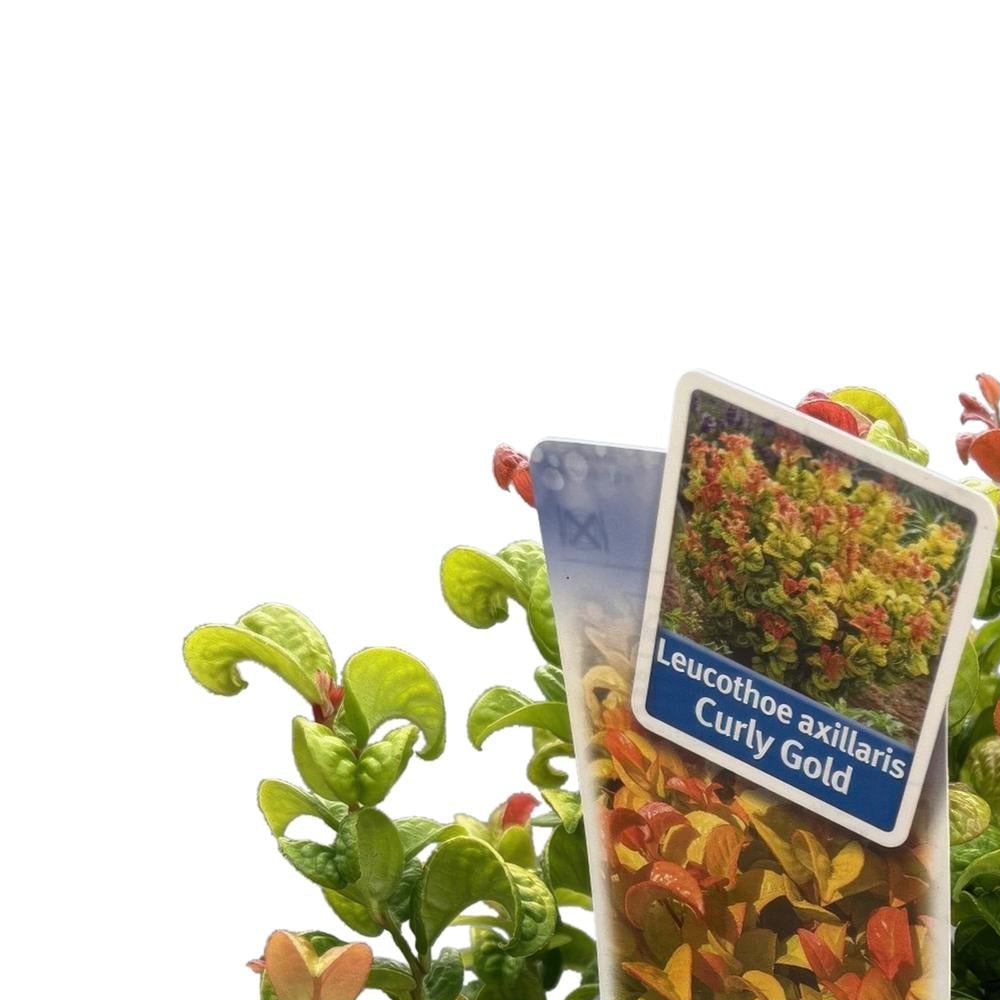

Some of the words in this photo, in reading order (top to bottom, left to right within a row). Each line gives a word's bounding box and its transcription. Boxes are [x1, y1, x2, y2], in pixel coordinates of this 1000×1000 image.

[656, 638, 793, 724] Leucothoe
[798, 713, 906, 779] axillaris
[695, 697, 775, 760] Curly
[780, 739, 853, 795] Gold
